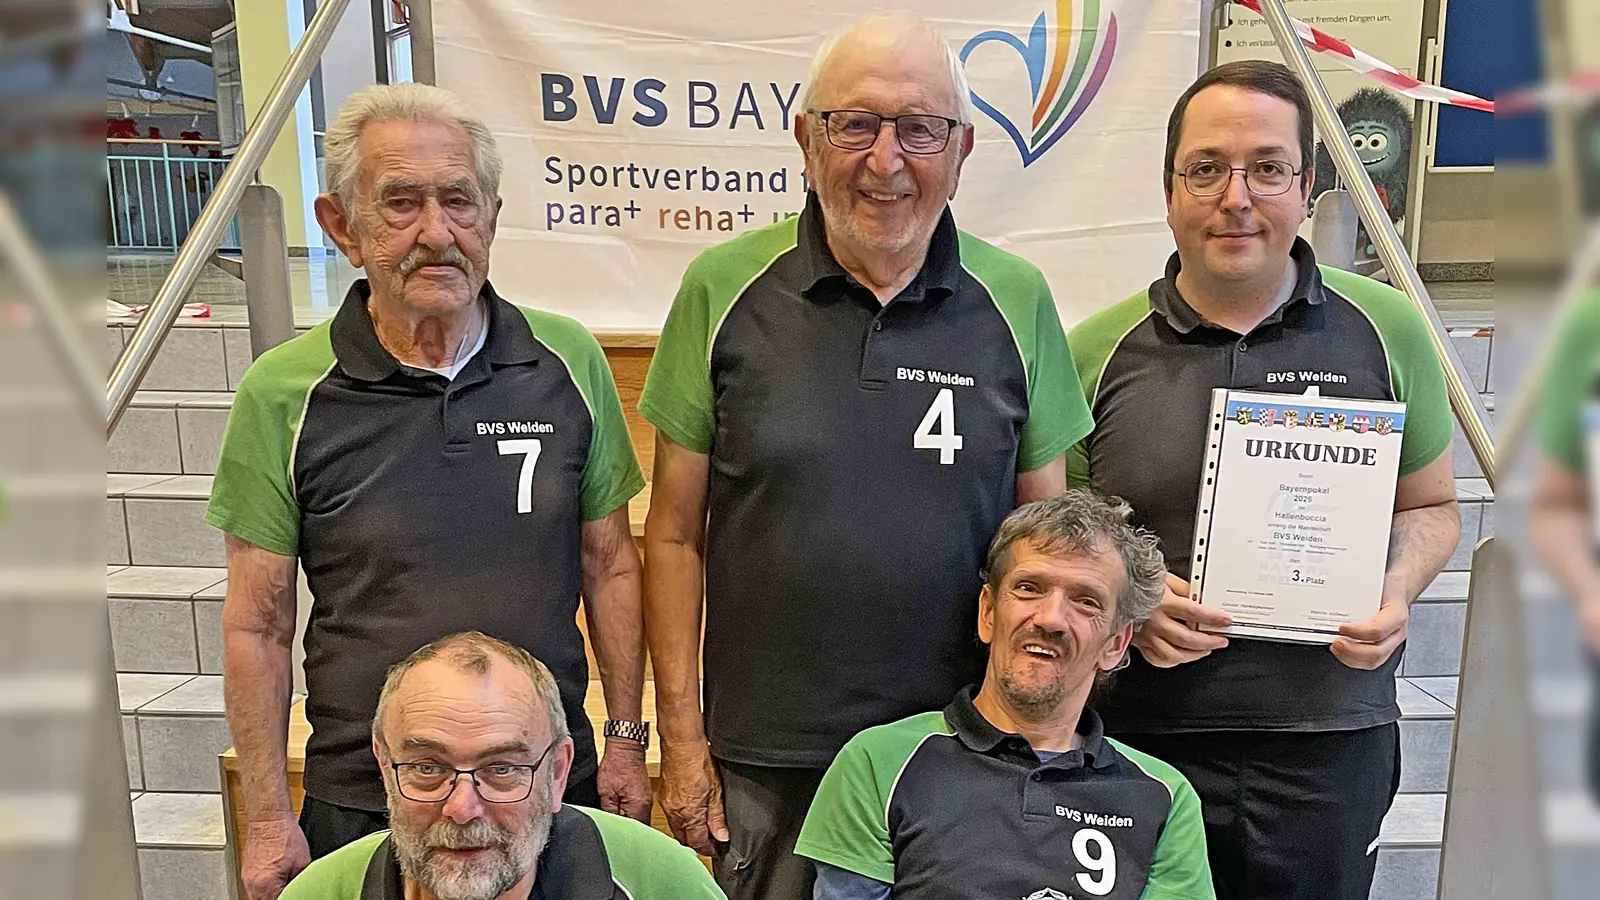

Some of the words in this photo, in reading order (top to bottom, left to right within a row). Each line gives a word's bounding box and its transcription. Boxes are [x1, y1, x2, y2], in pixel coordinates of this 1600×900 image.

[1237, 18, 1249, 26] Ich
[1316, 15, 1348, 23] fremden
[1349, 14, 1376, 23] Dingen
[541, 73, 668, 127] BVS
[688, 81, 801, 131] BAY
[545, 156, 786, 193] Sportverband
[896, 367, 925, 382] BVS
[927, 370, 975, 387] Weiden
[1266, 372, 1296, 383] BVS
[1298, 371, 1347, 384] Weiden
[476, 422, 506, 435] BVS
[506, 421, 554, 434] Weiden
[913, 388, 963, 464] 4
[1245, 438, 1377, 466] URKUNDE
[497, 439, 542, 514] 7
[1274, 511, 1327, 522] Hallenboccia
[1273, 532, 1291, 541] BVS
[1292, 534, 1323, 543] Weiden
[1291, 569, 1305, 582] 3.
[1306, 576, 1326, 585] Platz
[1055, 805, 1082, 823] BVS
[1083, 812, 1133, 827] Weiden
[1071, 828, 1117, 896] 9
